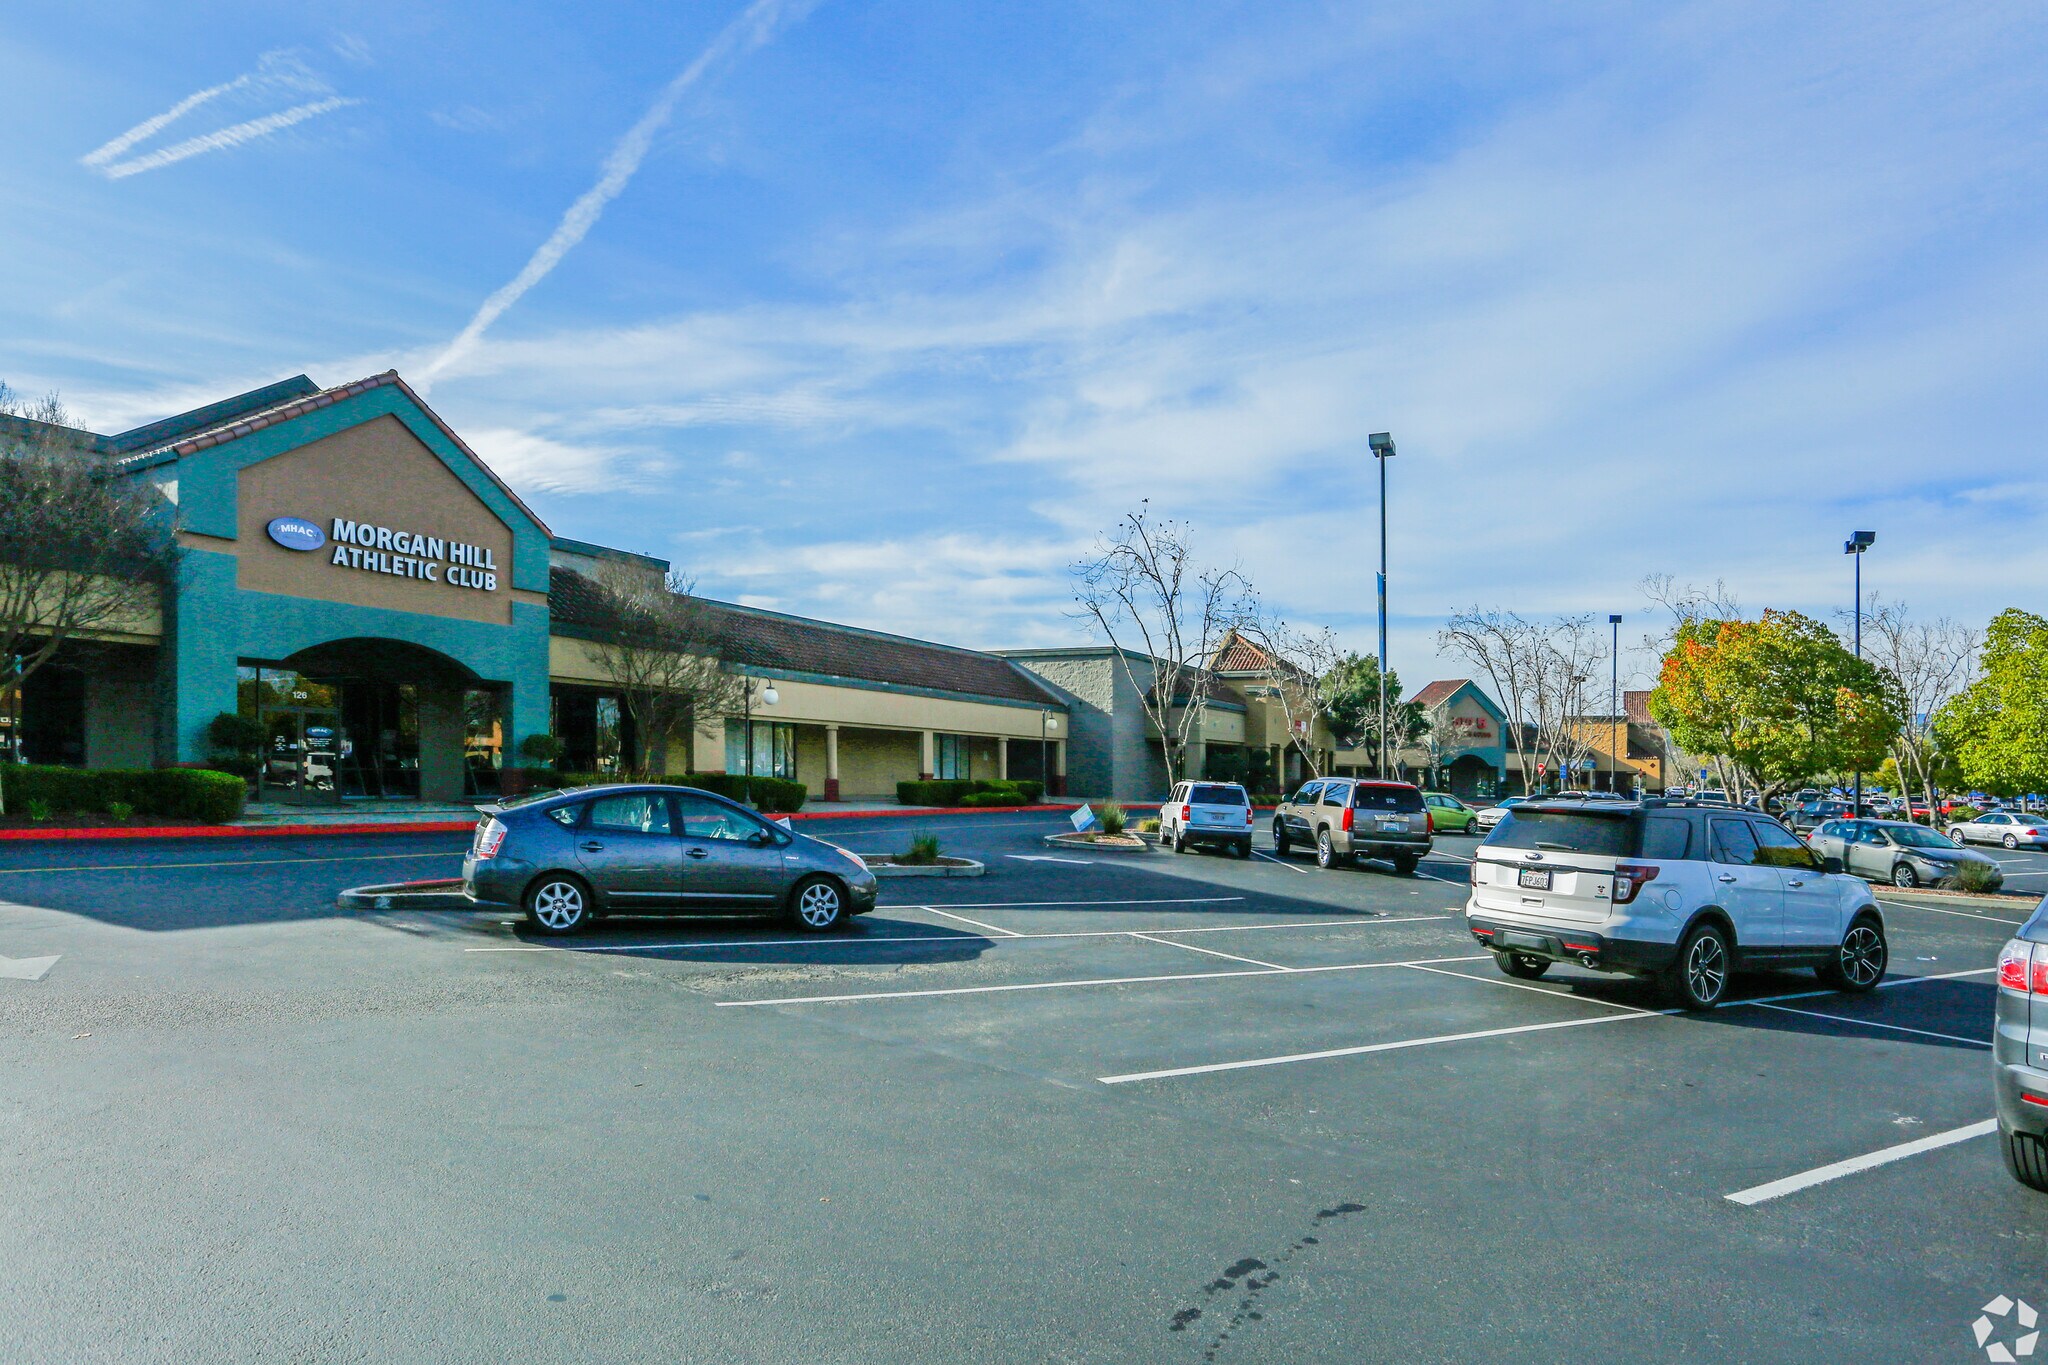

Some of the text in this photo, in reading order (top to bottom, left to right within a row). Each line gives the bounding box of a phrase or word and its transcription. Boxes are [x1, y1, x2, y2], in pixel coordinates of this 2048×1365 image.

[281, 524, 314, 537] MHAC
[333, 517, 497, 570] MORGAN HILL
[332, 545, 497, 591] ATHLETIC CLUB
[292, 691, 308, 699] 126
